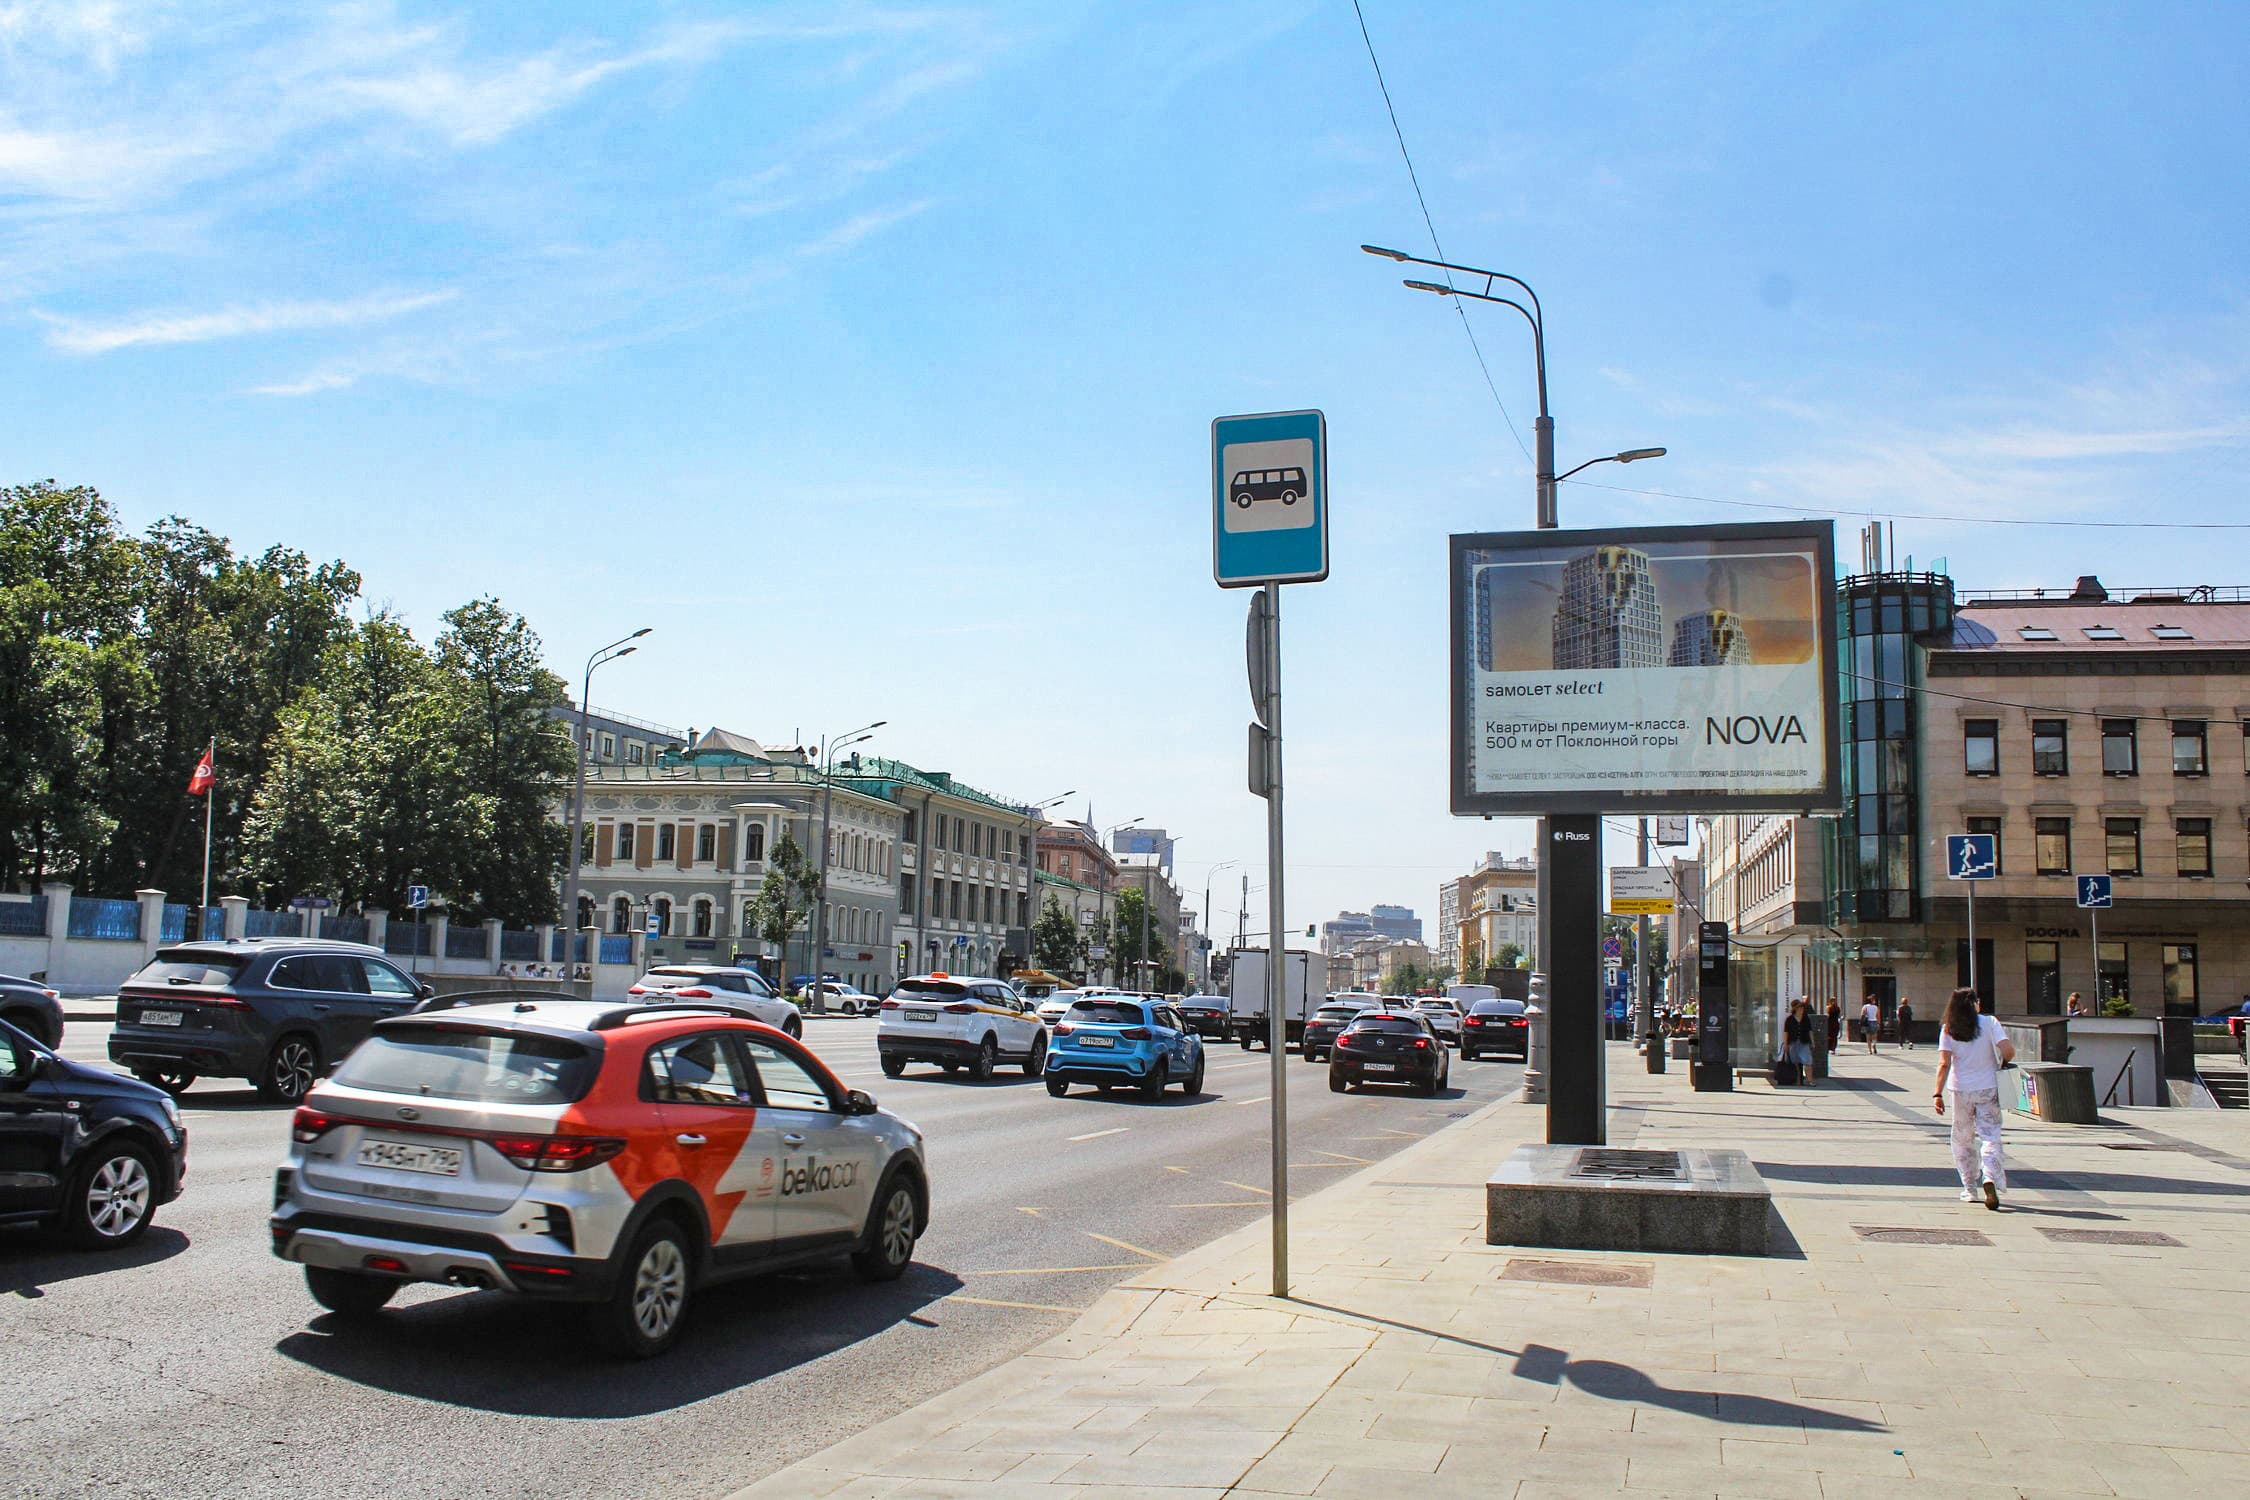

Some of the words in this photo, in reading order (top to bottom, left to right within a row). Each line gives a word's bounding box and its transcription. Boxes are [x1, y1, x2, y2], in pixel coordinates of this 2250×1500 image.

[1555, 681, 1604, 695] select
[1486, 721, 1557, 735] Квартиры
[1561, 719, 1690, 735] премиум-класса.
[1706, 715, 1807, 745] NOVA
[1486, 736, 1517, 749] 500
[1521, 738, 1532, 748] м
[1536, 738, 1552, 748] от
[1556, 733, 1638, 748] Поклонной
[1642, 735, 1678, 749] горы
[1565, 831, 1590, 840] Russ
[2025, 927, 2080, 938] DOGMA
[1861, 967, 1893, 975] DOGMA
[782, 1156, 860, 1195] belkacar
